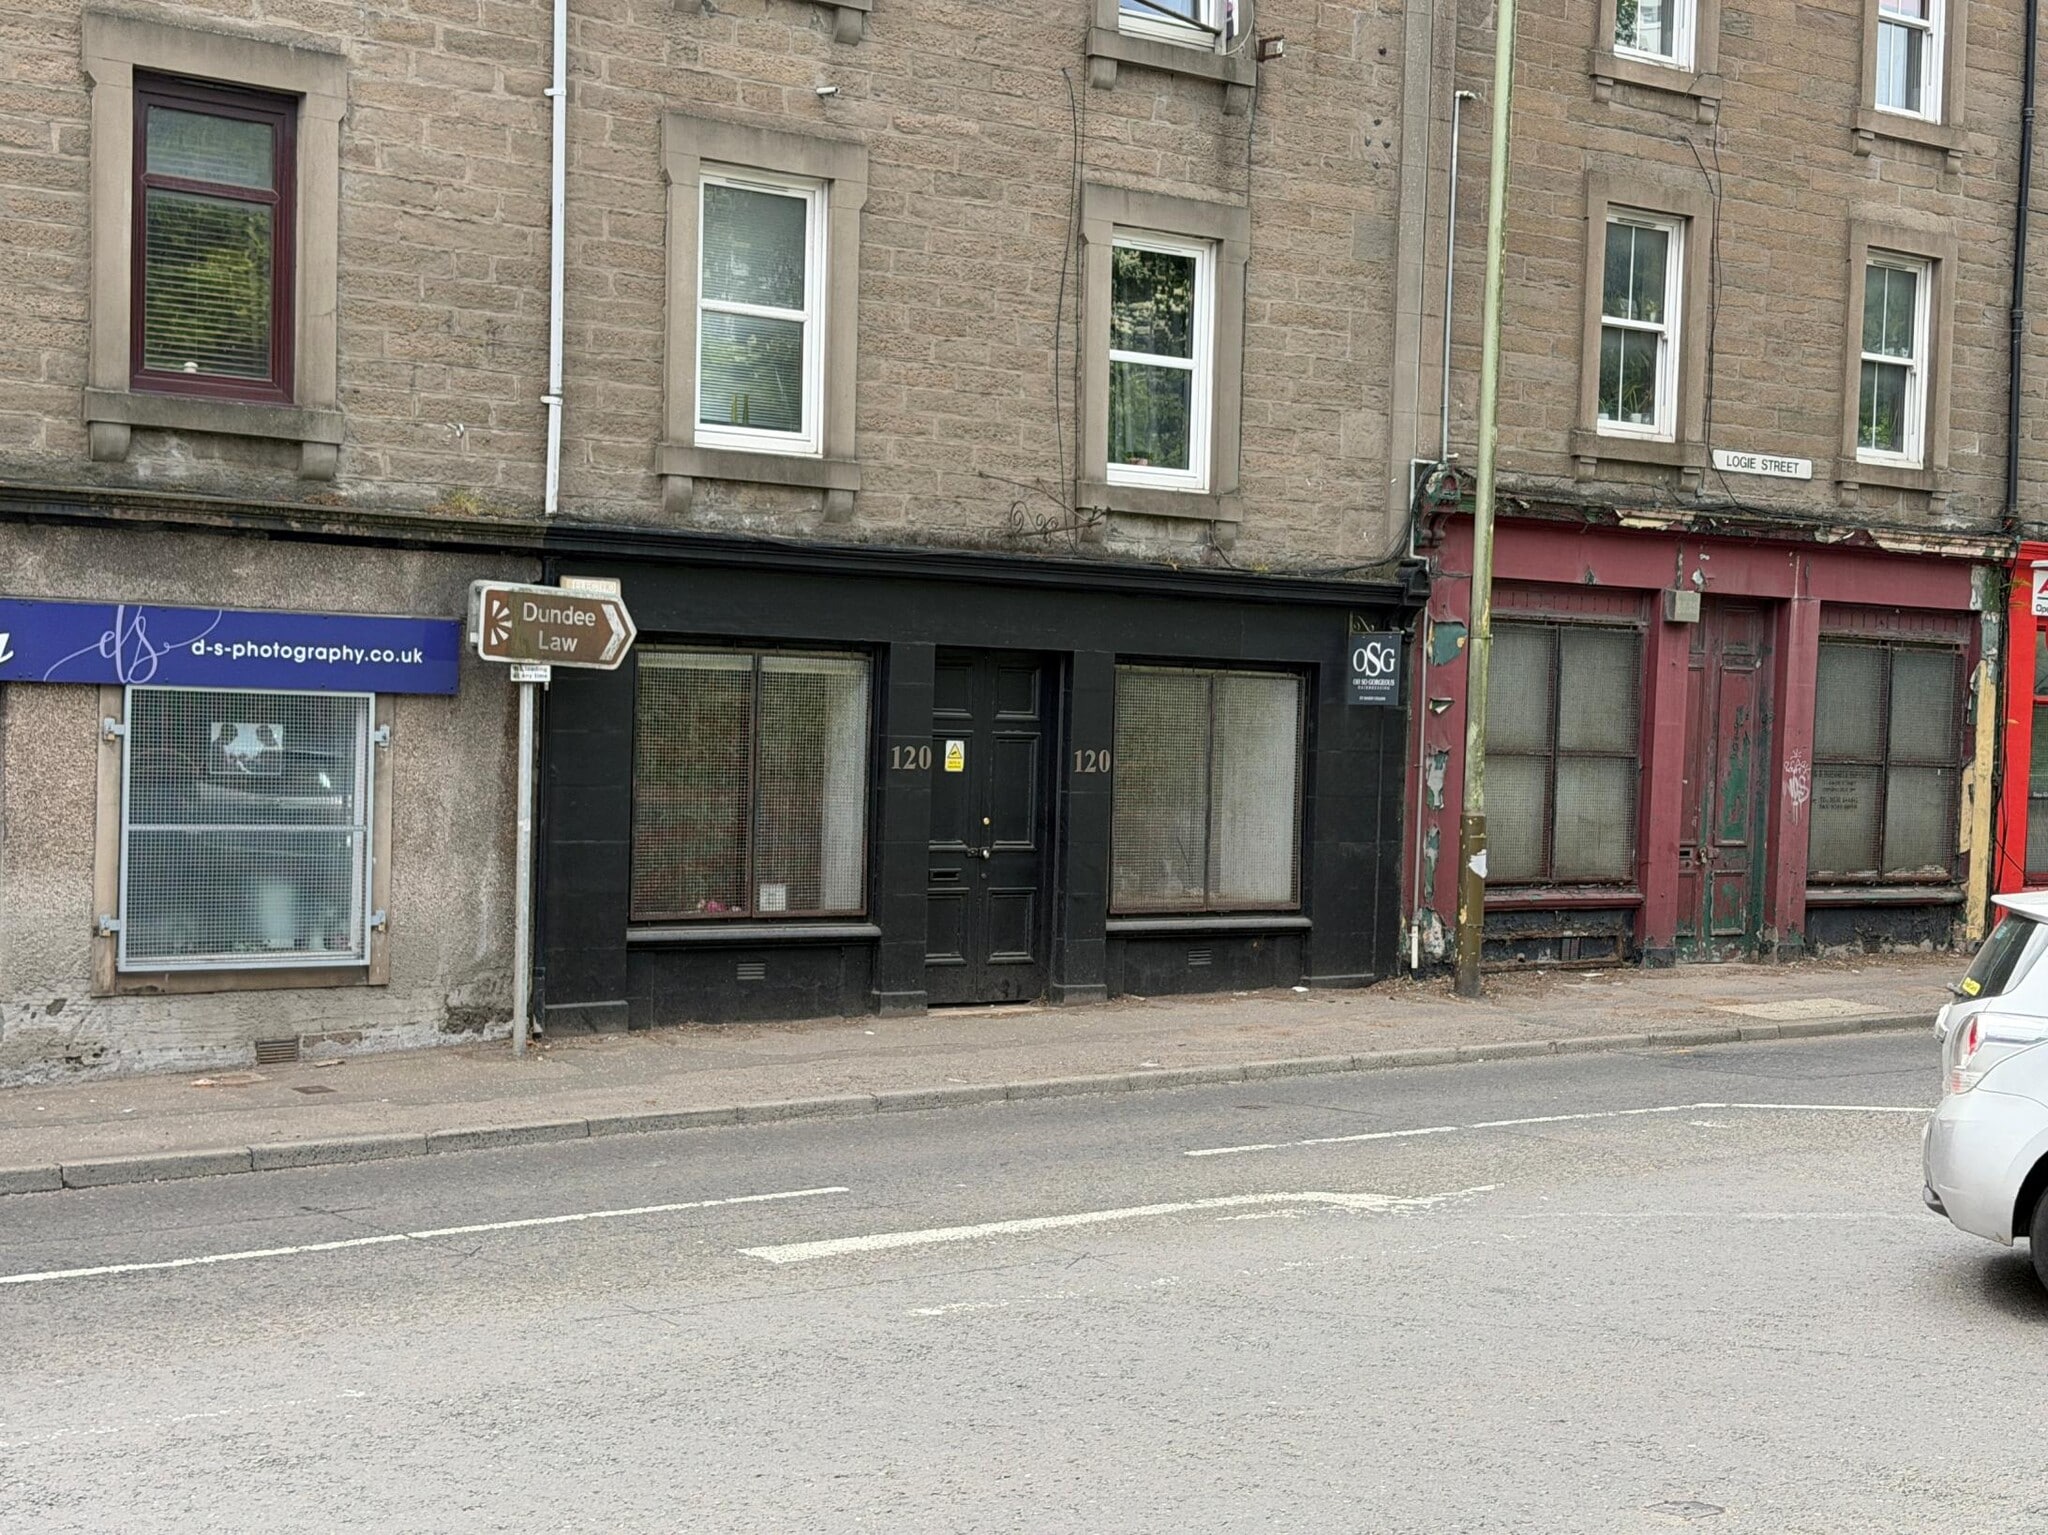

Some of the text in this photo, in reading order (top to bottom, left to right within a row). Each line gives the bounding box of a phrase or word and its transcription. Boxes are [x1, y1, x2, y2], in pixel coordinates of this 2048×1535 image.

[1726, 455, 1799, 474] LOGIE STREET
[522, 602, 596, 627] Dundee
[191, 639, 423, 664] d-s-photography.co.uk
[538, 630, 578, 652] Law
[1352, 641, 1396, 677] OSG
[890, 745, 932, 770] 120
[1074, 749, 1111, 773] 120
